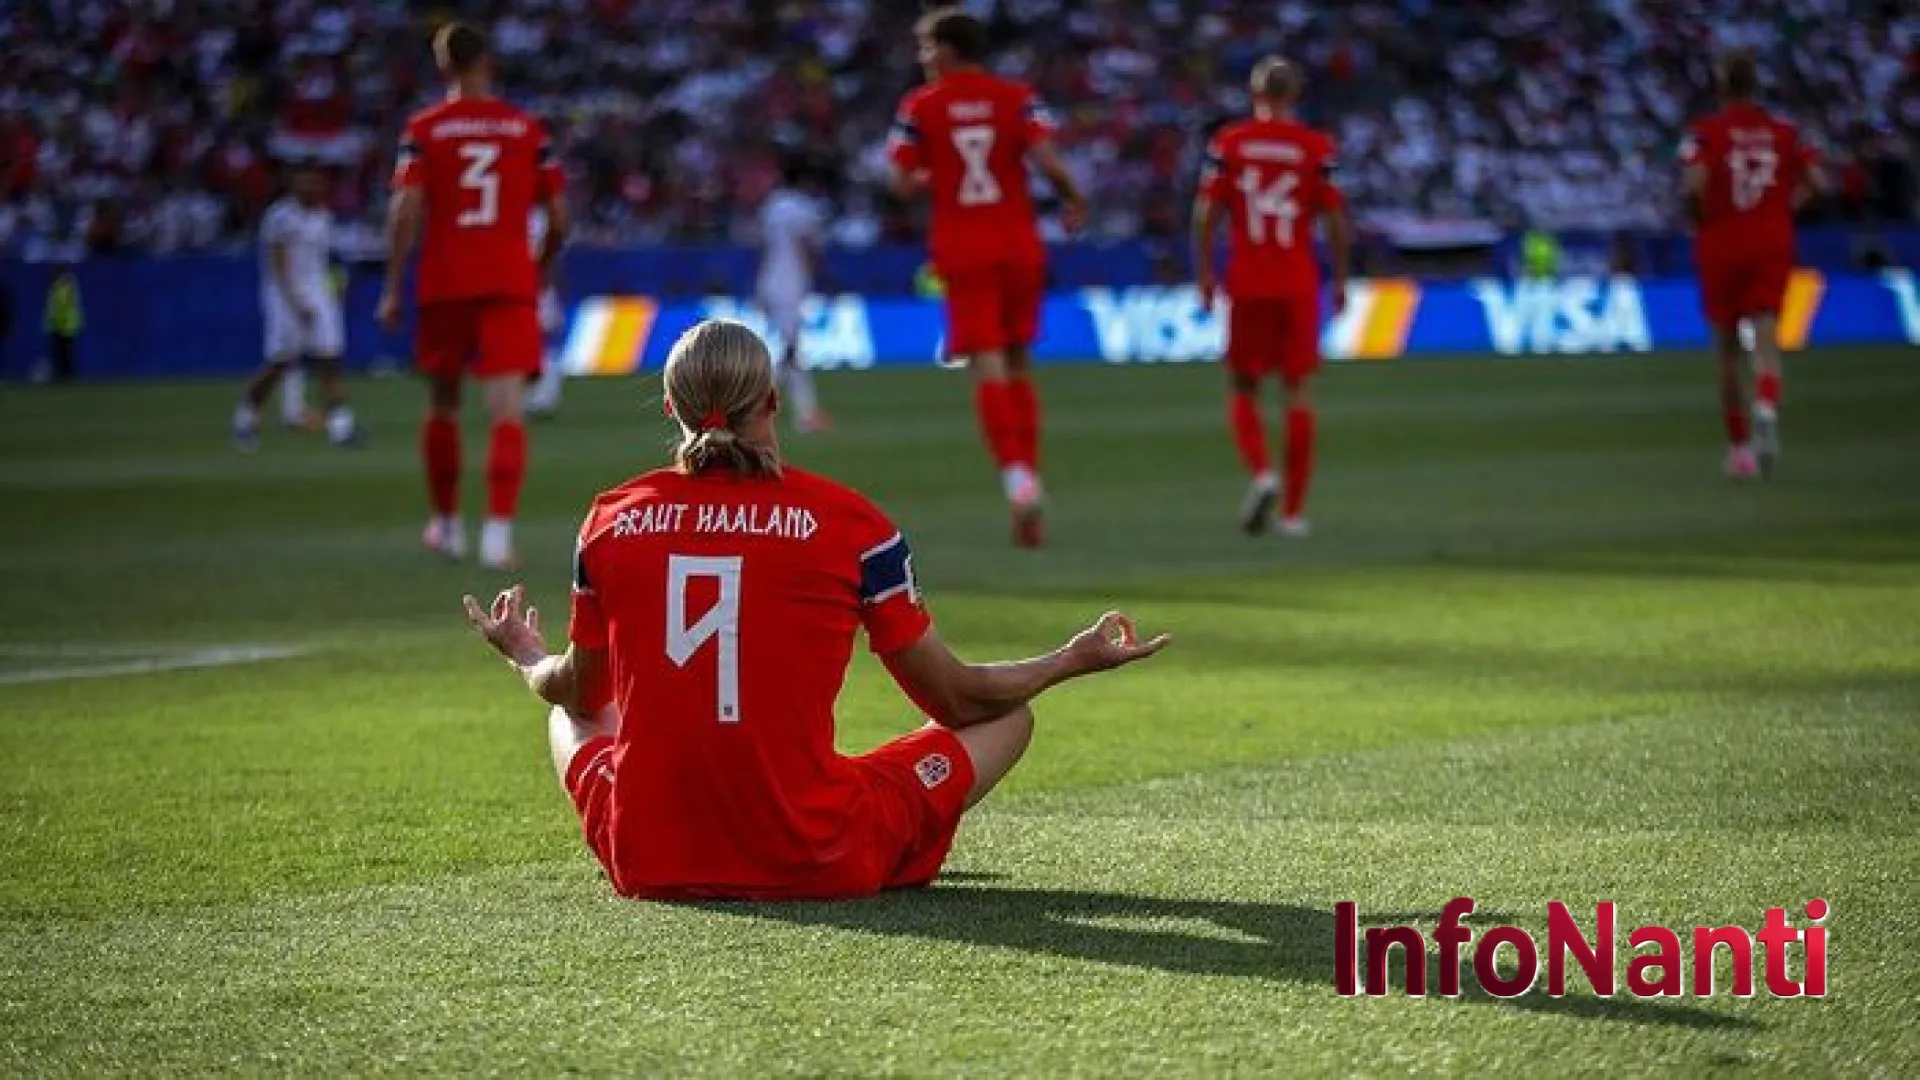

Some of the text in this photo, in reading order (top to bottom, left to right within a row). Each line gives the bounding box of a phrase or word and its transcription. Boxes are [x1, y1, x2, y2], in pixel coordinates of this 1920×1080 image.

[457, 142, 500, 228] 3
[951, 126, 1003, 205] 8
[1235, 165, 1300, 247] 14
[1466, 274, 1654, 354] VISA
[696, 503, 818, 540] HAALAND
[664, 553, 744, 724] 9
